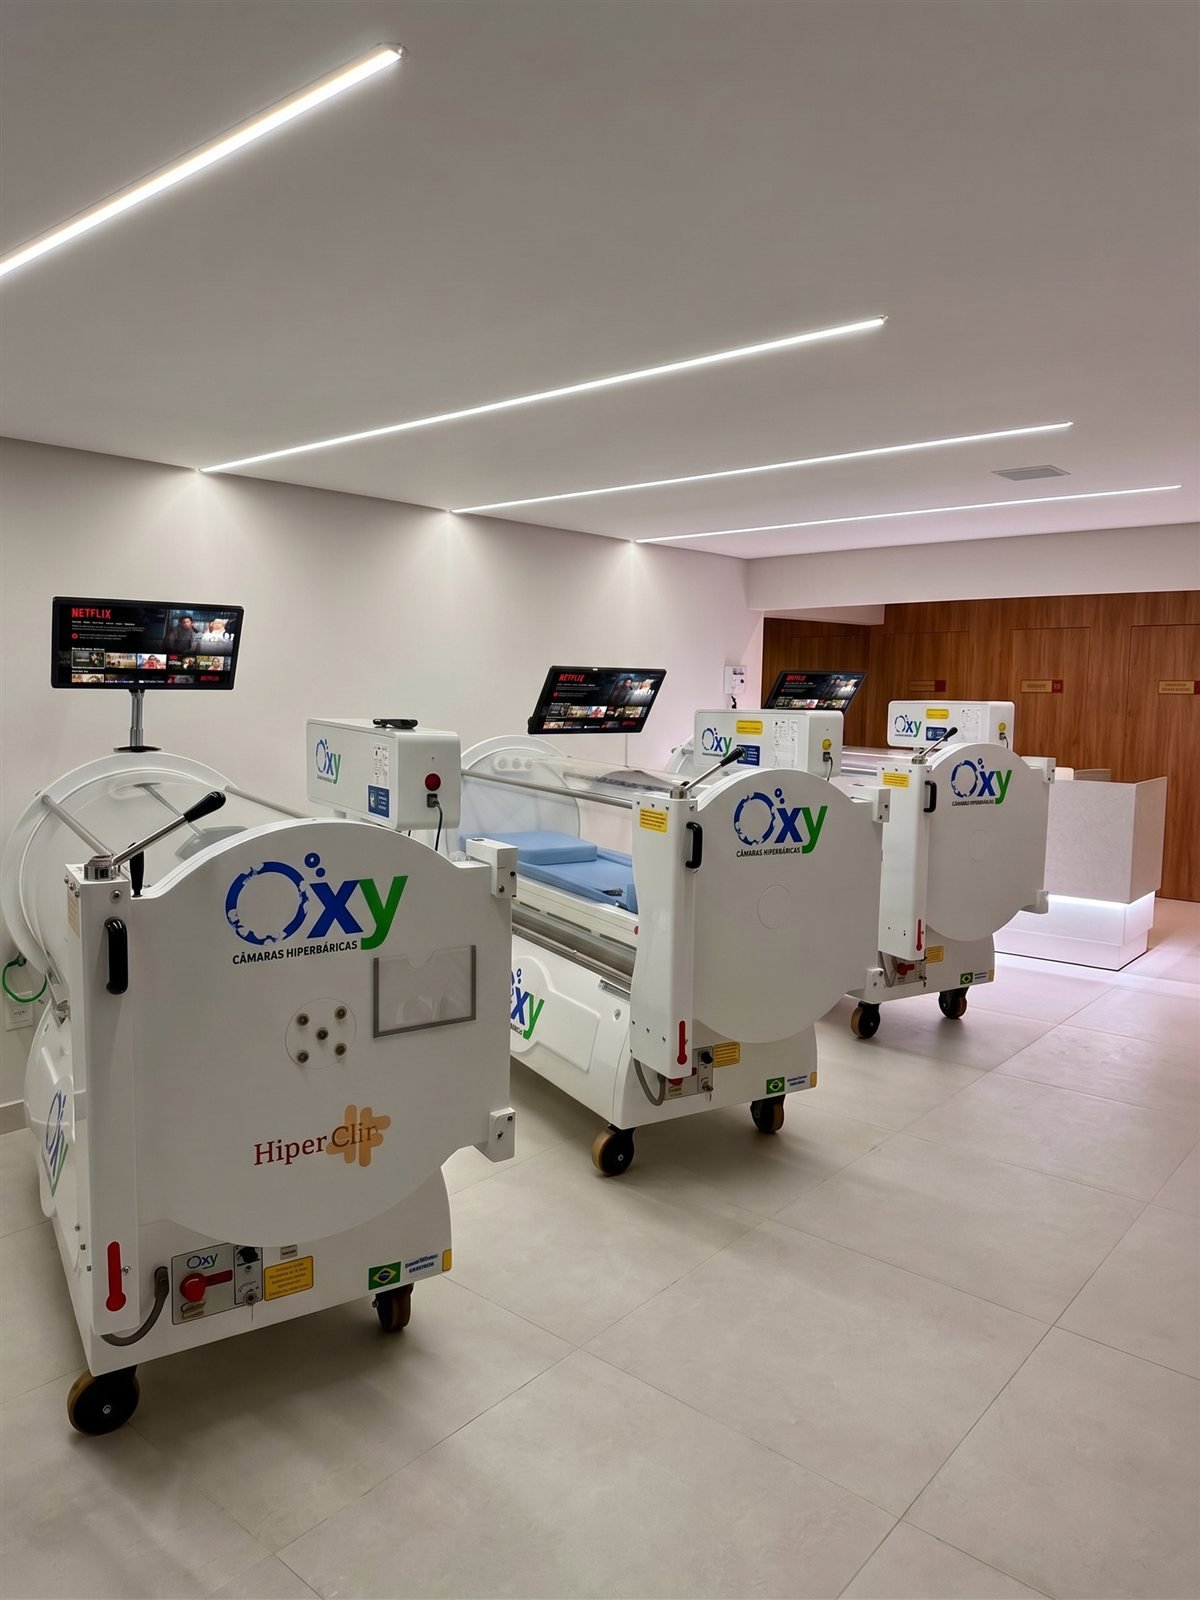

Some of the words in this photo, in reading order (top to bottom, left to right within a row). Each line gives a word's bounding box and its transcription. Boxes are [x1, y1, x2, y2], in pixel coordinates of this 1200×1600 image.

[71, 607, 112, 619] NETFLIX
[894, 714, 922, 737] Oxy
[701, 727, 732, 757] Oxy
[315, 738, 341, 784] Oxy
[950, 758, 1013, 804] Oxy
[733, 788, 829, 854] Oxy
[736, 848, 763, 858] CÂMARAS
[763, 846, 801, 856] HIPERBÁRICAS
[225, 853, 409, 950] Oxy
[232, 949, 285, 965] CÂMARAS
[286, 940, 359, 958] HIPERBÁRICAS
[510, 970, 545, 1041] xy
[186, 1253, 219, 1270] Oxy
